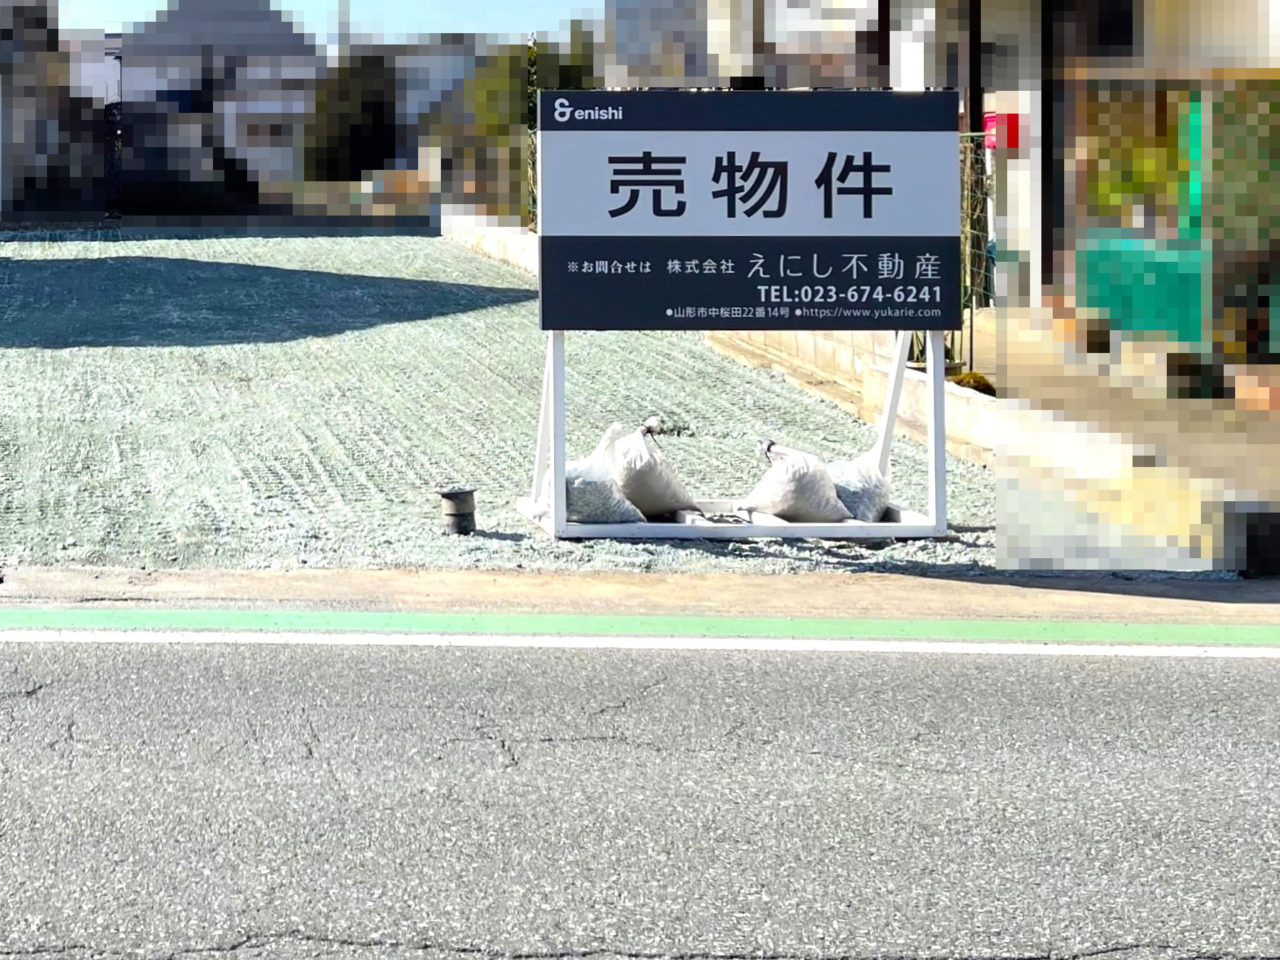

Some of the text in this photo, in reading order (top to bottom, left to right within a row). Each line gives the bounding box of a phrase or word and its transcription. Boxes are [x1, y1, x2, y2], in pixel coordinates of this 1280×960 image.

[574, 106, 623, 120] enishi
[607, 151, 894, 219] 売物件
[666, 259, 735, 274] 株式会社
[747, 252, 942, 280] えにし不動産
[757, 286, 942, 302] TEL:023-674-6241
